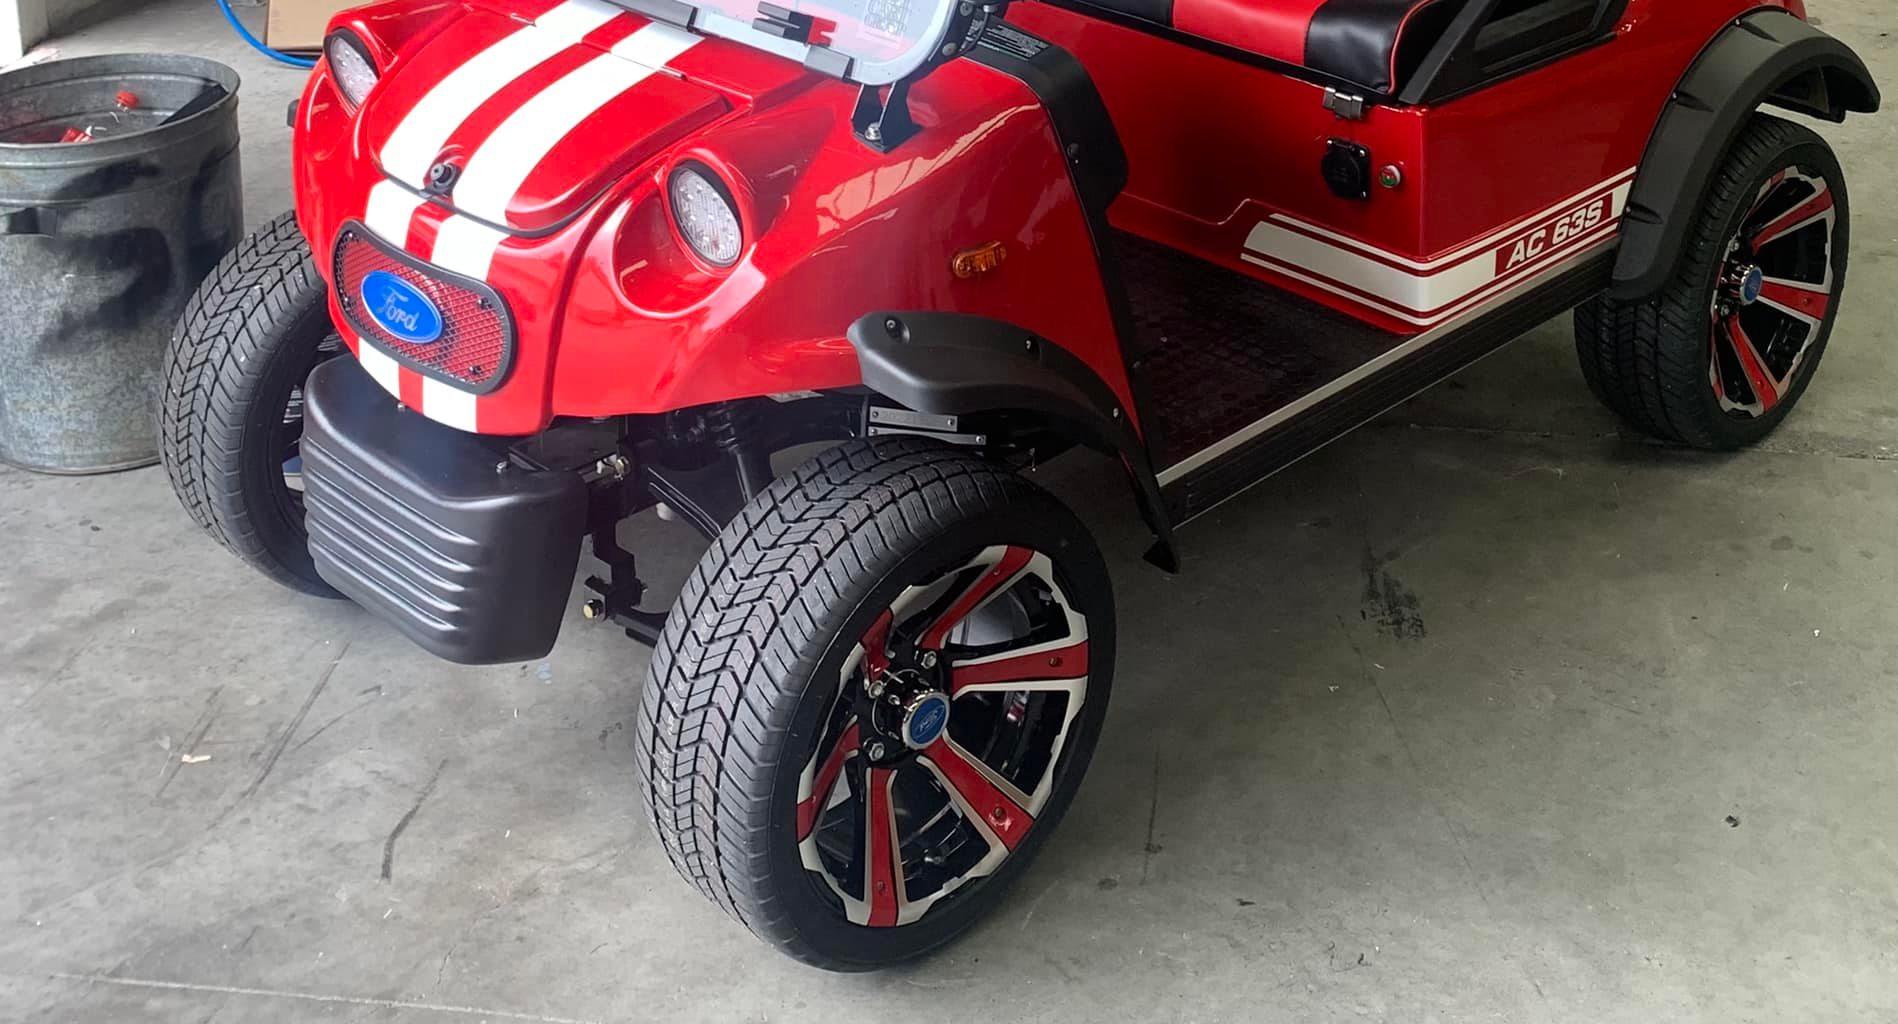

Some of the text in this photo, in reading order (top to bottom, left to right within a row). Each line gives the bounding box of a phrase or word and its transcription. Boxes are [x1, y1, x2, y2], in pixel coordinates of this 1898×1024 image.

[1506, 200, 1604, 269] AC 63S
[380, 286, 419, 332] Ford
